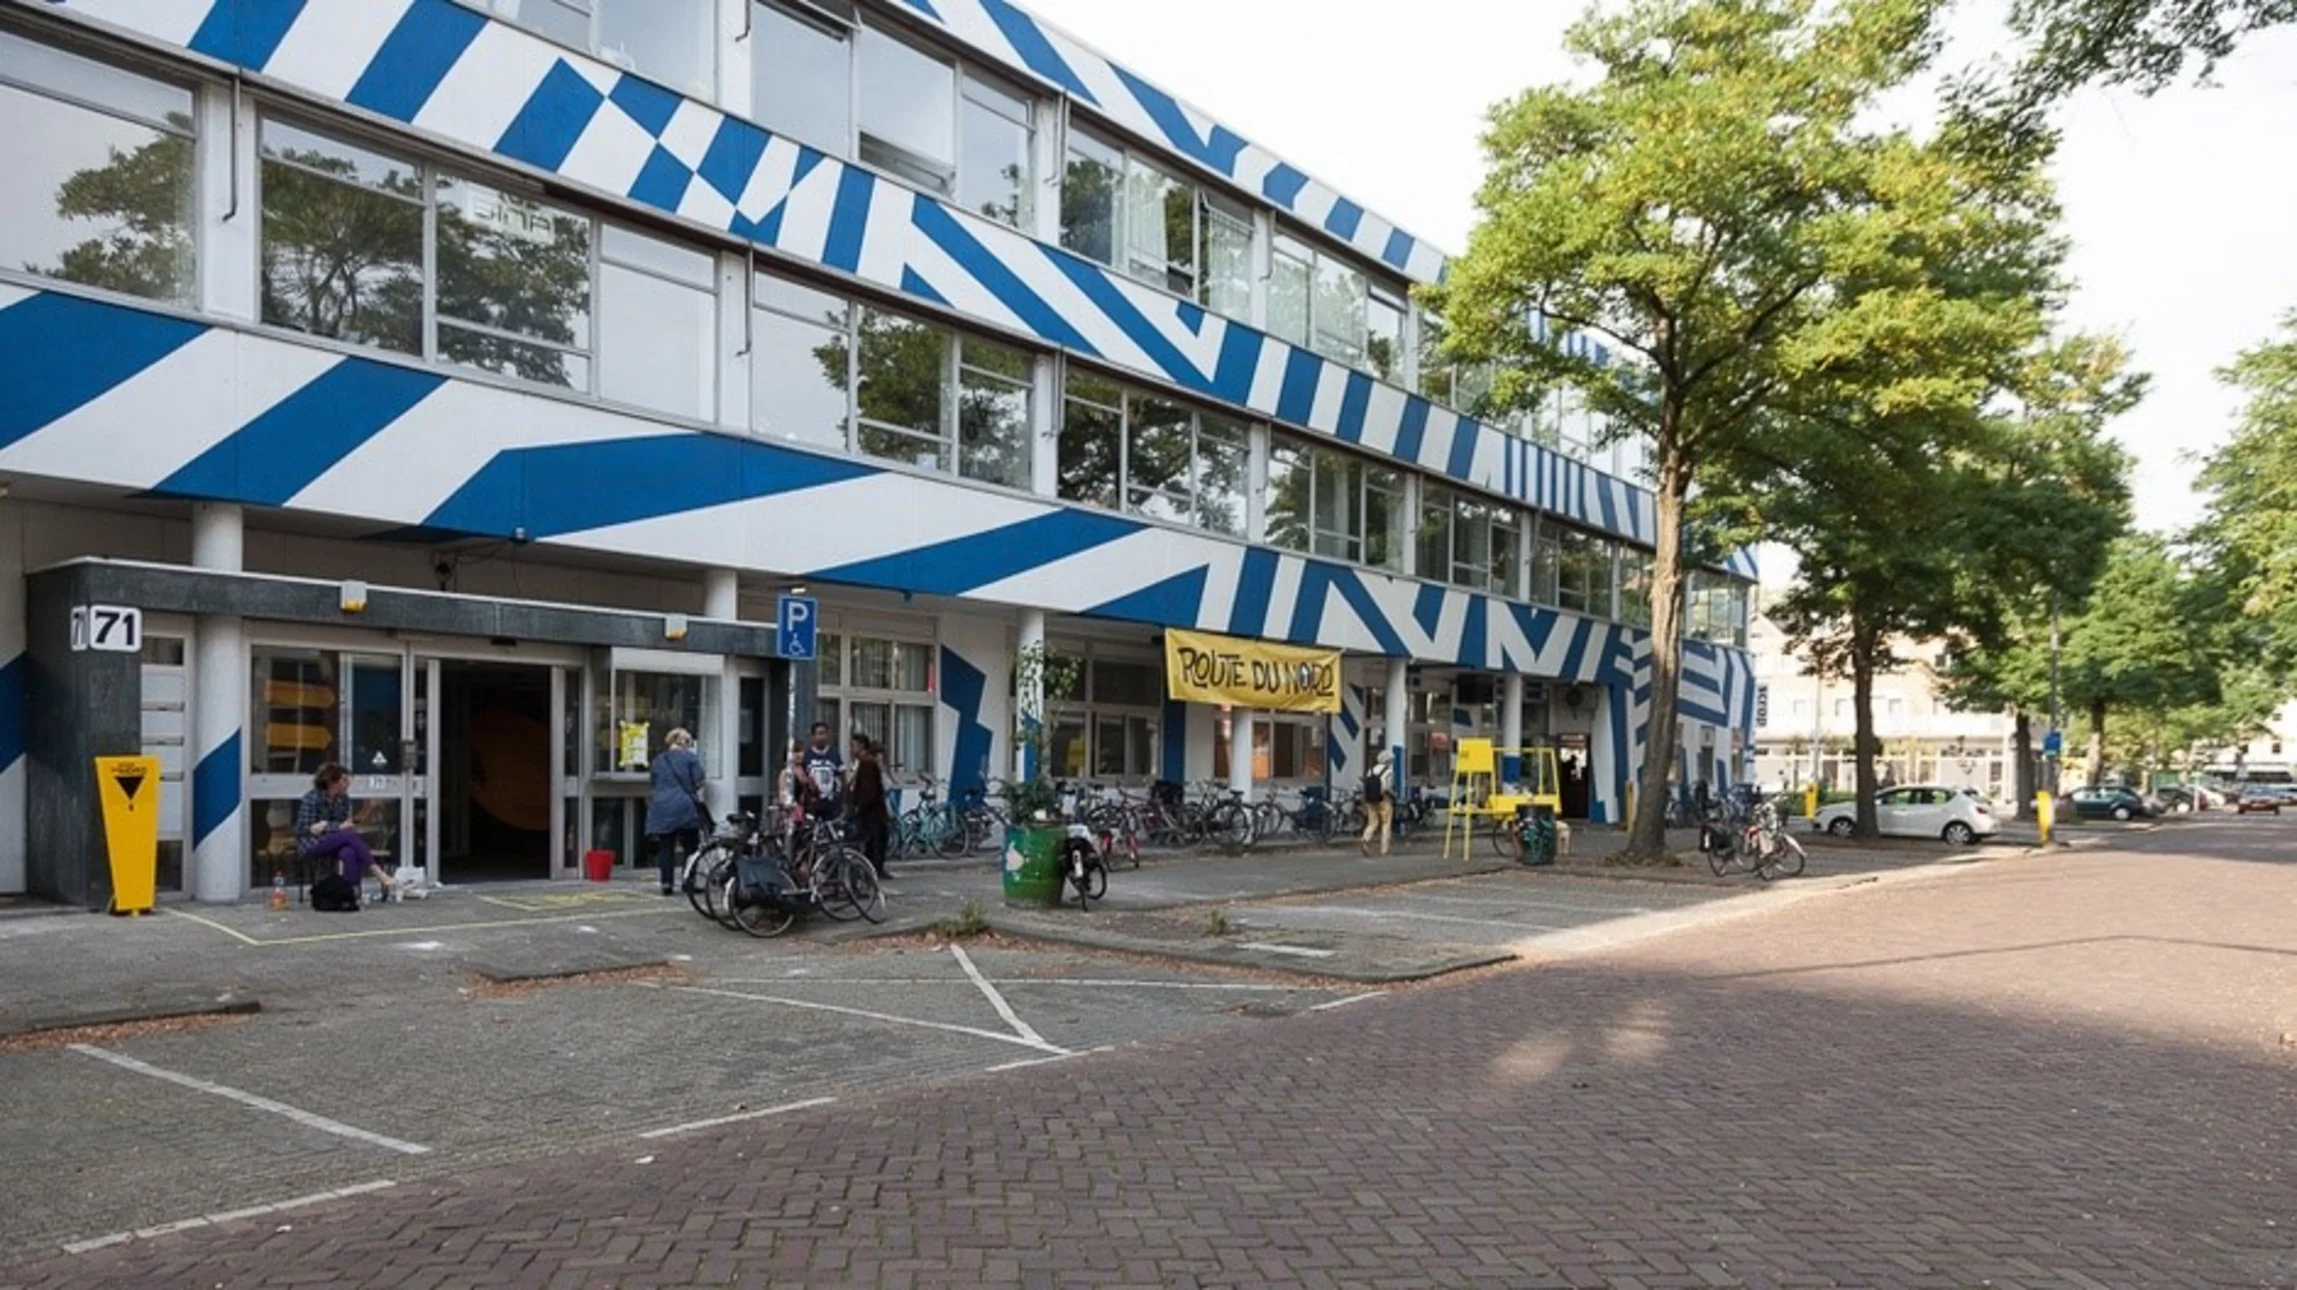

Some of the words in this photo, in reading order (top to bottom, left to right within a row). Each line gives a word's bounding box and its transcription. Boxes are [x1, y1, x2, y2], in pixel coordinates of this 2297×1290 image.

[95, 610, 135, 646] 71
[787, 601, 809, 631] P
[1177, 647, 1247, 689] ROUTE
[1251, 660, 1281, 694] DU
[1284, 661, 1334, 697] NORD
